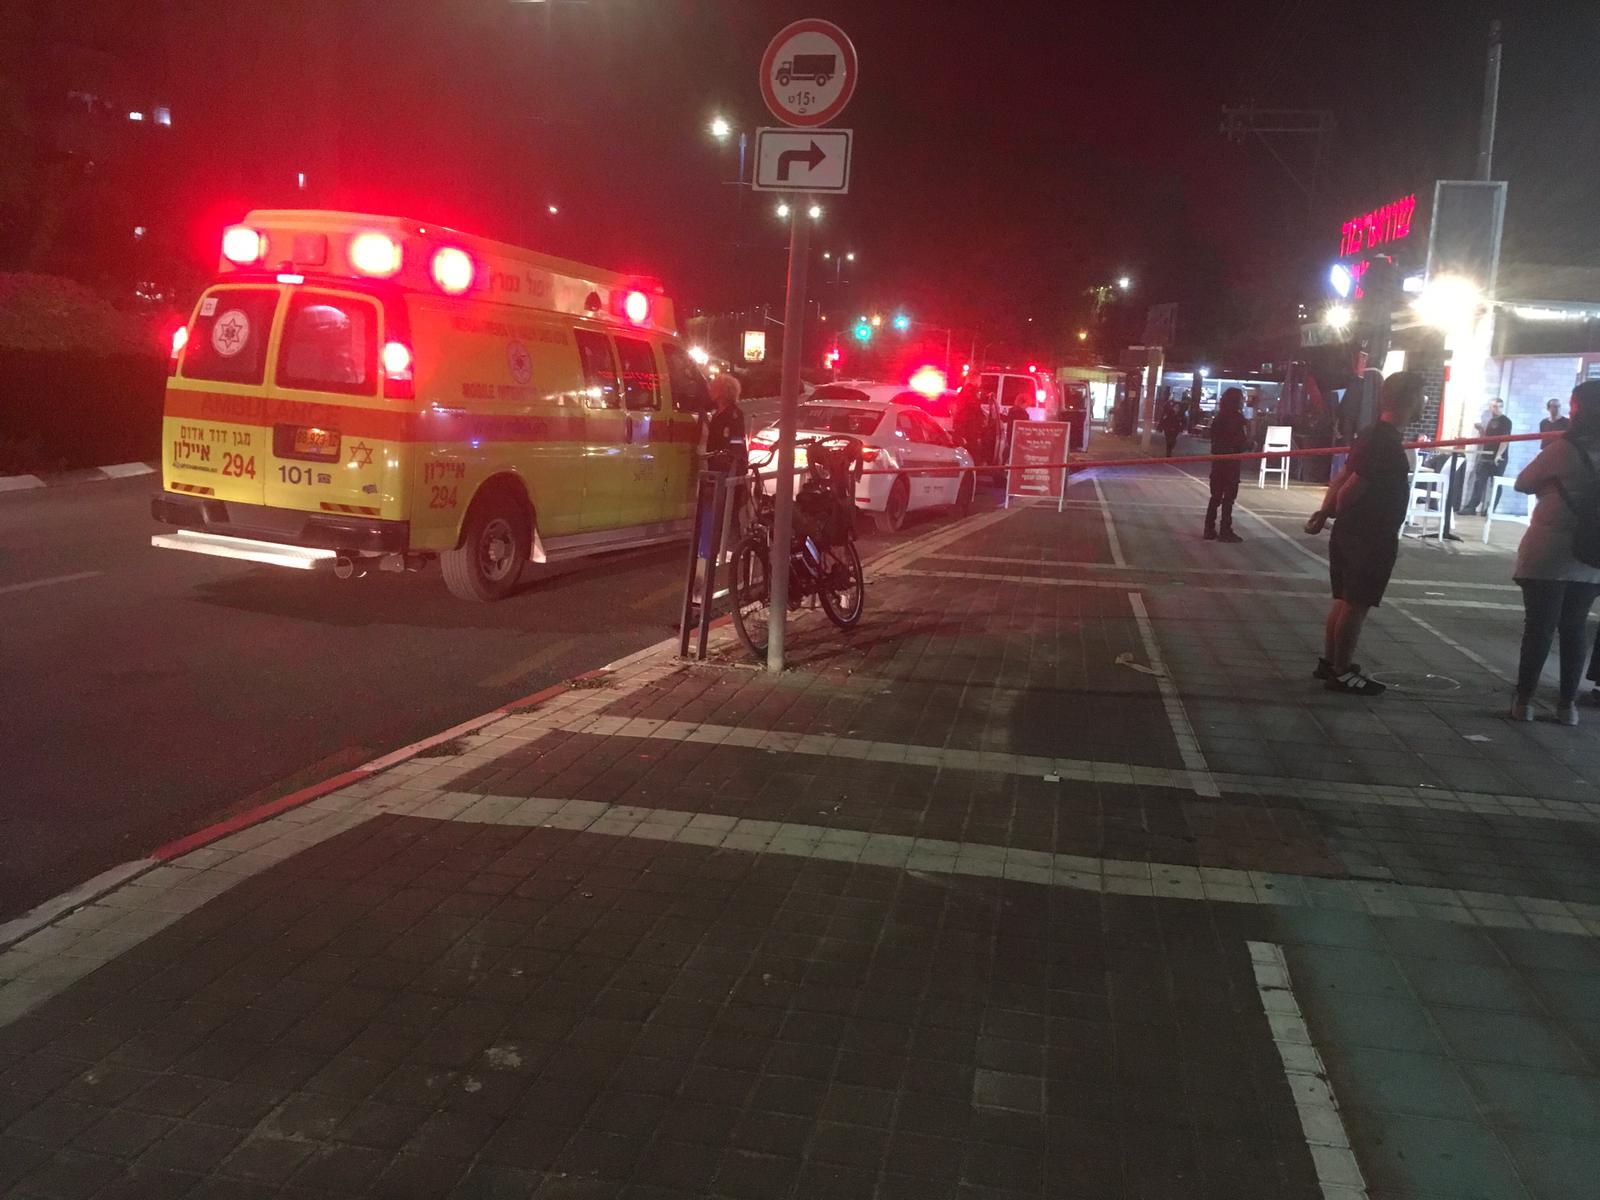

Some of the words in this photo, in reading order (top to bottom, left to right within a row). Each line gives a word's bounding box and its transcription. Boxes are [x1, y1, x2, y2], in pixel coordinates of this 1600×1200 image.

[181, 424, 204, 441] אדום
[209, 428, 228, 443] דוד
[232, 431, 251, 447] מגן
[173, 440, 211, 462] איילון
[222, 451, 256, 480] 294
[278, 465, 312, 486] 101
[429, 484, 458, 510] 294
